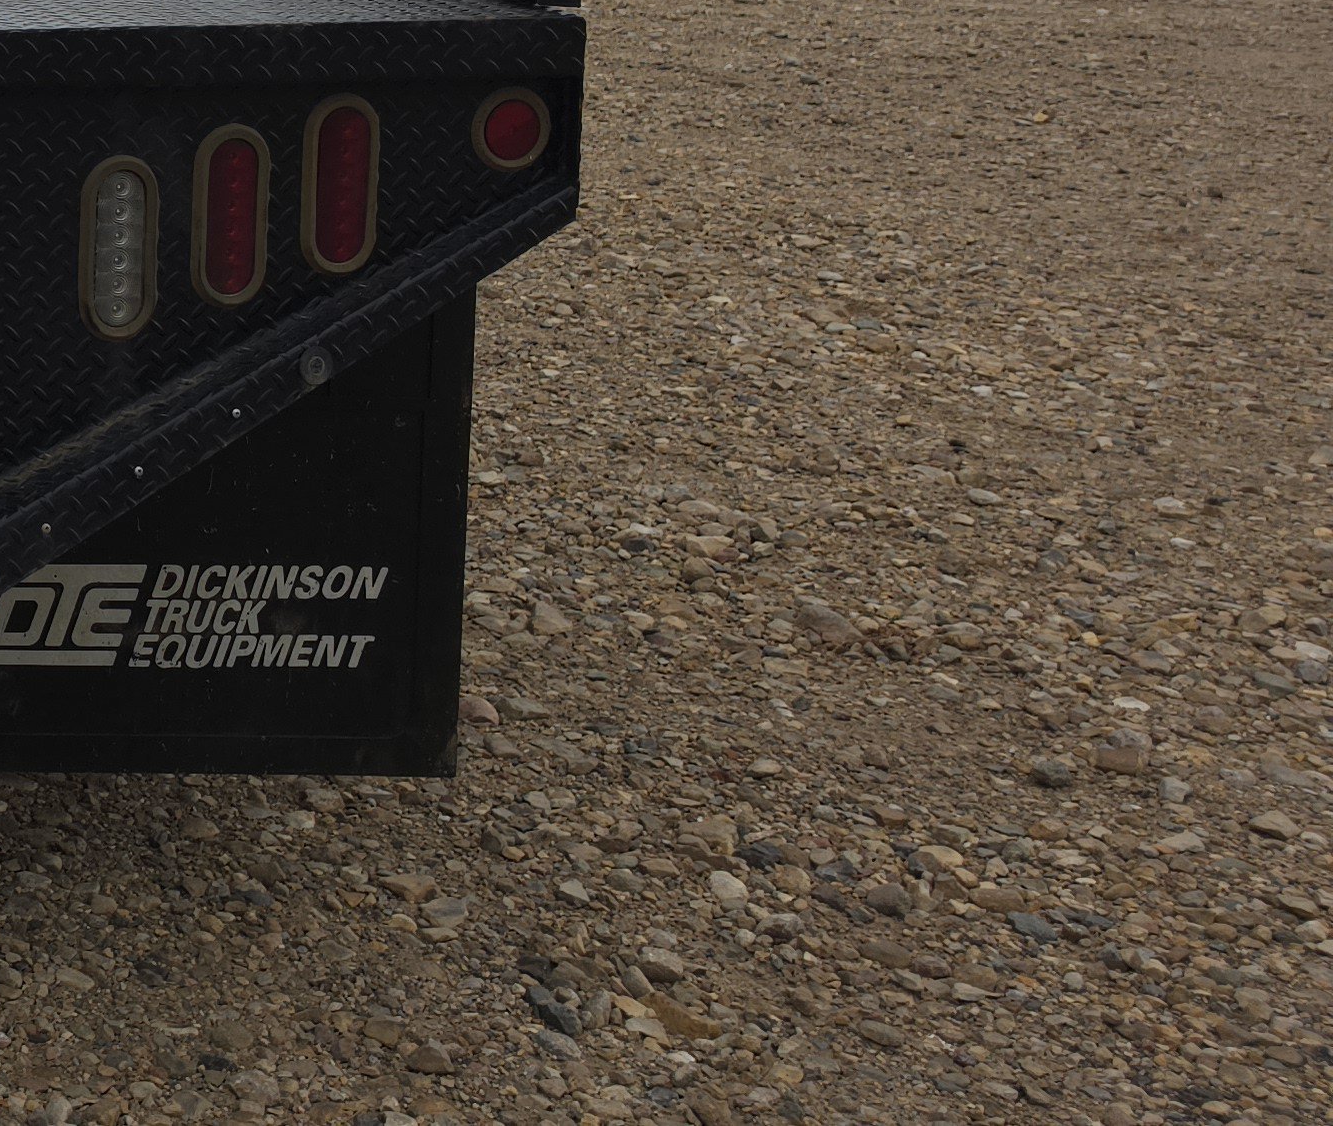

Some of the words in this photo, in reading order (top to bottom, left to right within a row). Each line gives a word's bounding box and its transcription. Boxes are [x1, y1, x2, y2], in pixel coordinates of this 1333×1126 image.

[150, 563, 389, 600] DICKINSON
[143, 599, 268, 635] TRUCK
[127, 633, 376, 669] EQUIPMENT
